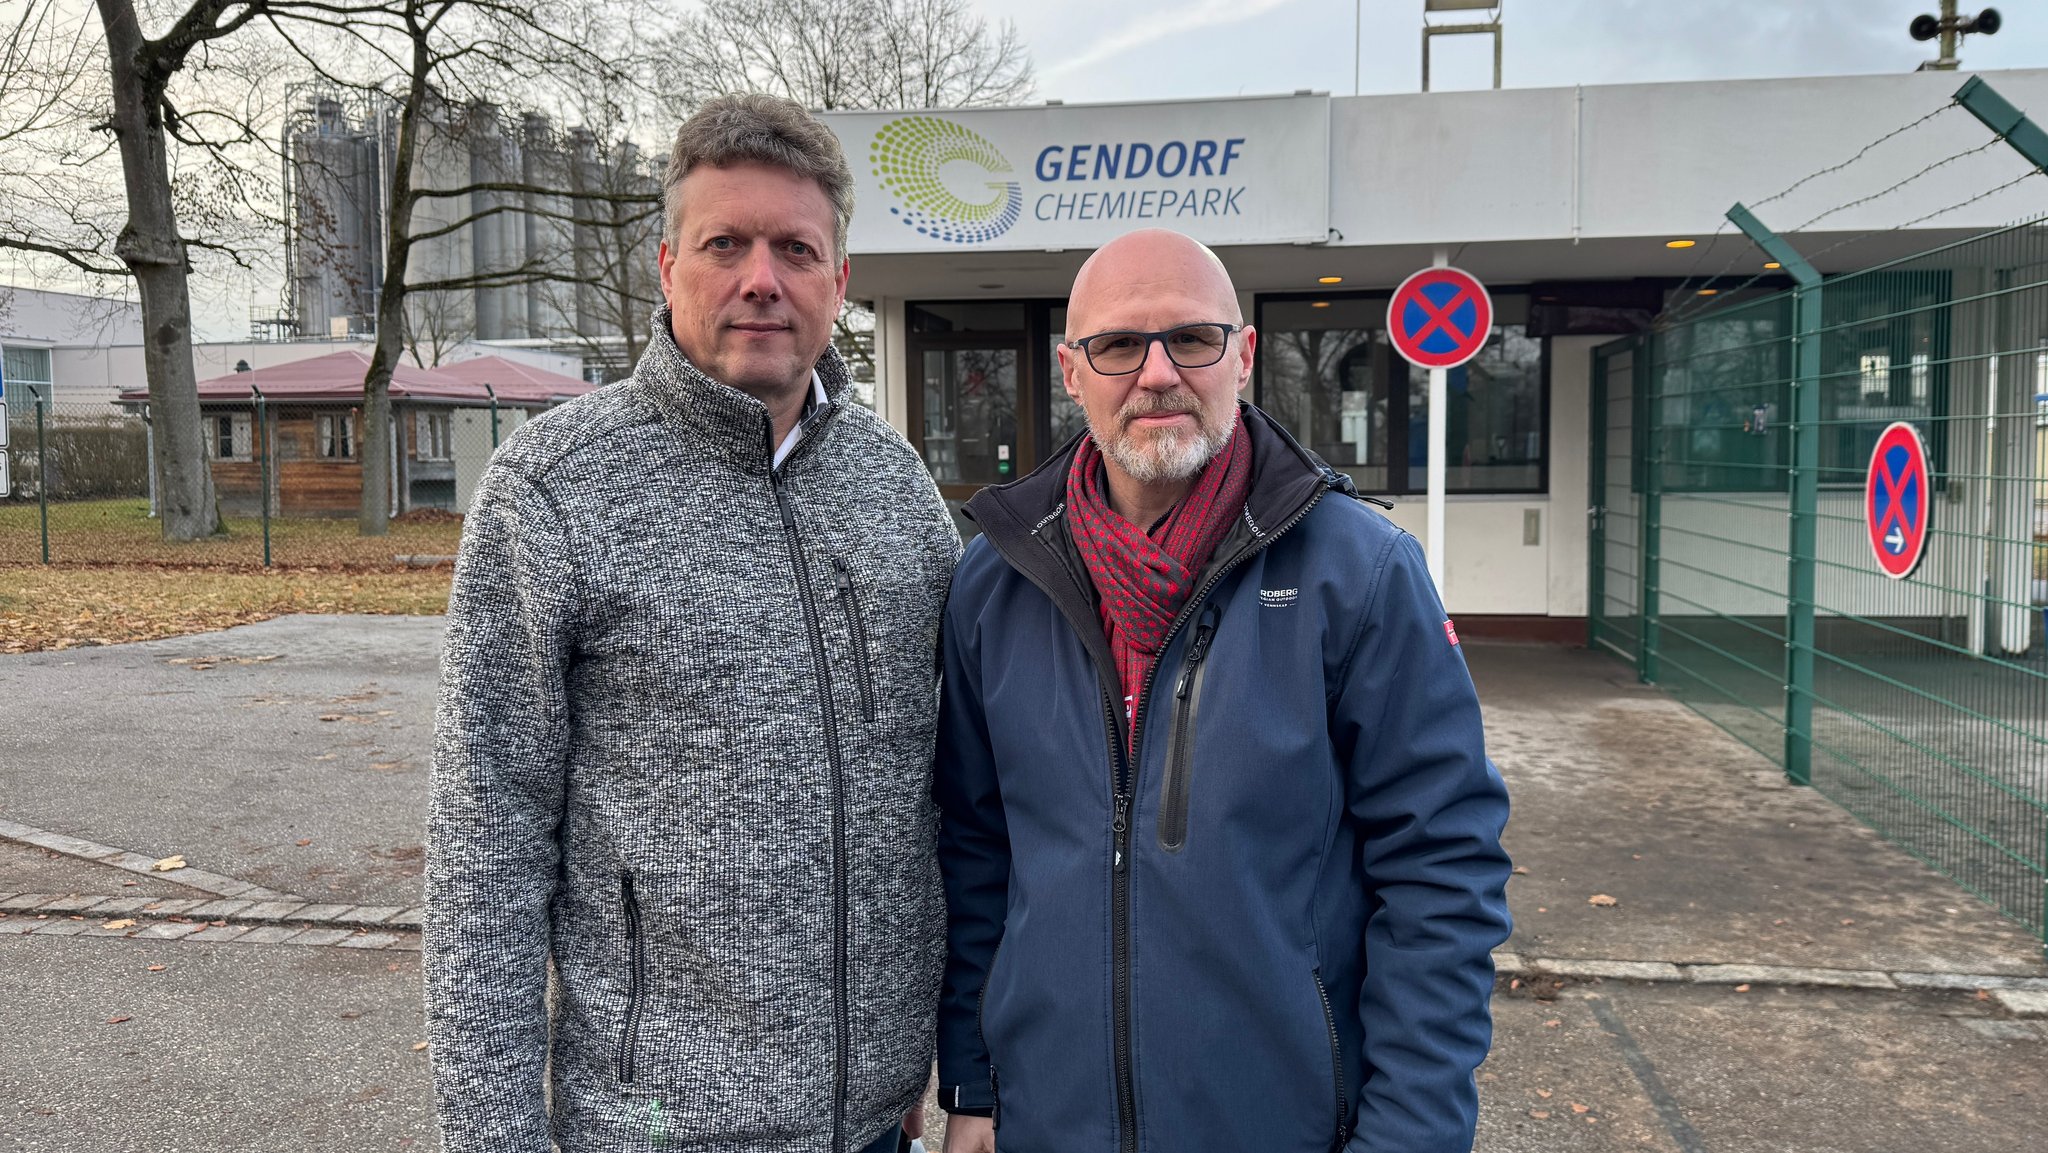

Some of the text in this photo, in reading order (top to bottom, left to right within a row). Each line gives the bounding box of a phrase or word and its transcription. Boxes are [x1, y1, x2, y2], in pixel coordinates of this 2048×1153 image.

[1035, 138, 1246, 182] GENDORF
[1035, 186, 1246, 221] CHEMIEPARK
[1036, 502, 1065, 529] OUTDOOR
[1260, 588, 1298, 598] RDBERG
